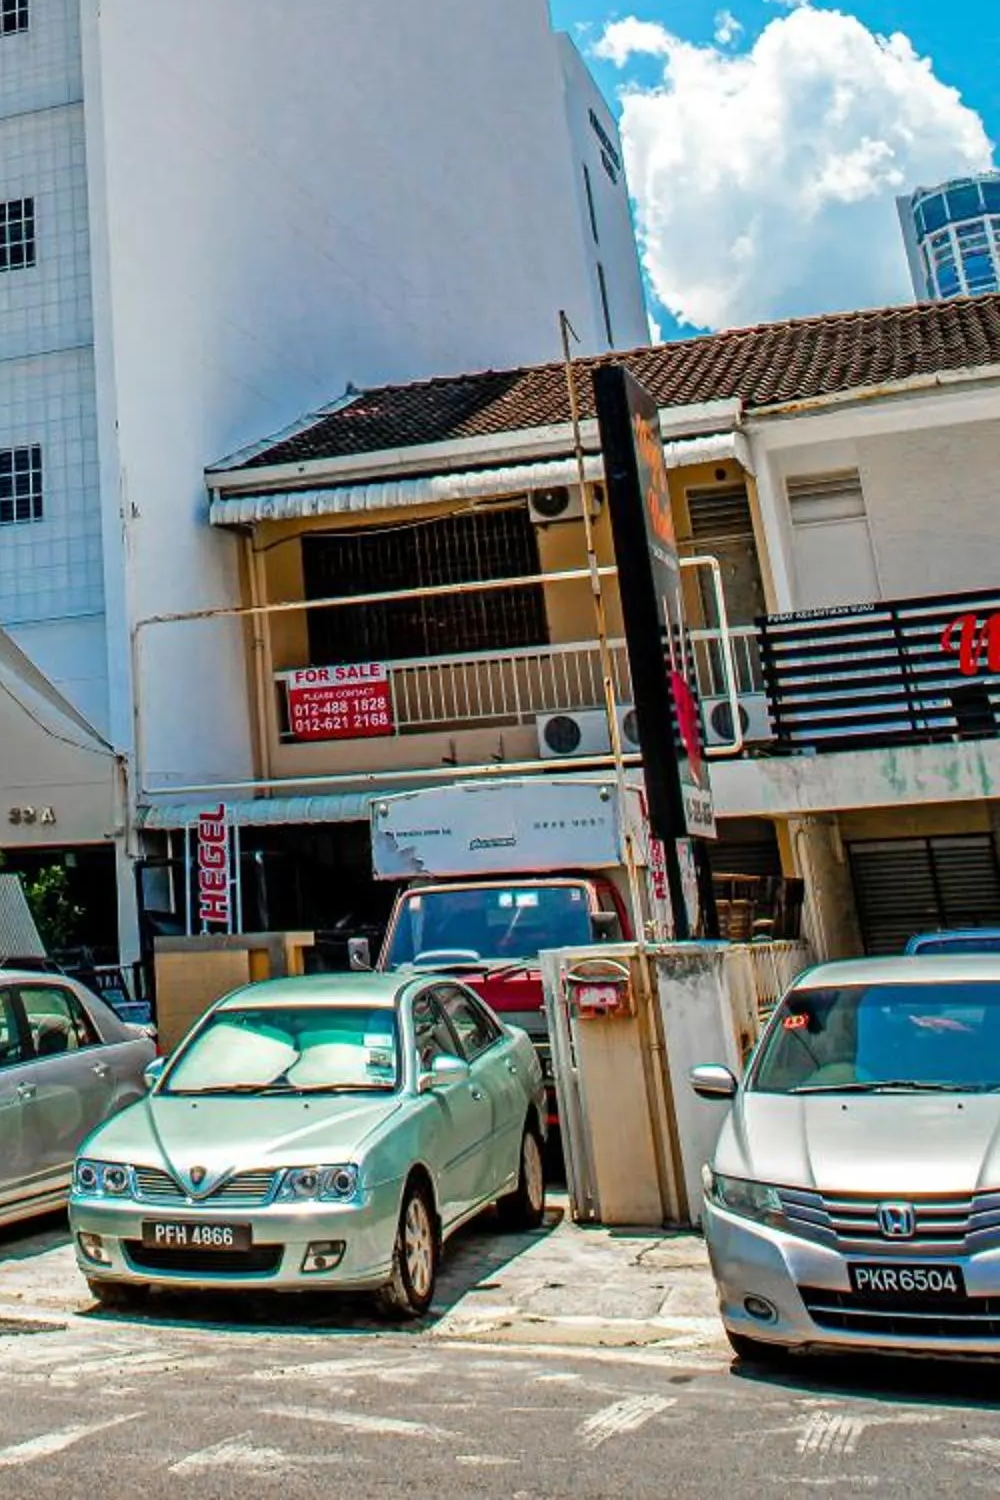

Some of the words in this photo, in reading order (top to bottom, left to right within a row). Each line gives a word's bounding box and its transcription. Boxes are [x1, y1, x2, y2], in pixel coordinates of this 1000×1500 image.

[295, 668, 329, 683] FOR
[335, 663, 381, 680] SALE
[303, 691, 334, 701] PLEASE
[336, 687, 375, 699] CONTACT
[294, 700, 349, 717] 012-488
[352, 696, 387, 713] 1828
[295, 715, 349, 733] 012-621
[198, 802, 228, 922] HEGEL
[155, 1223, 187, 1245] PFH
[191, 1225, 234, 1246] 4866
